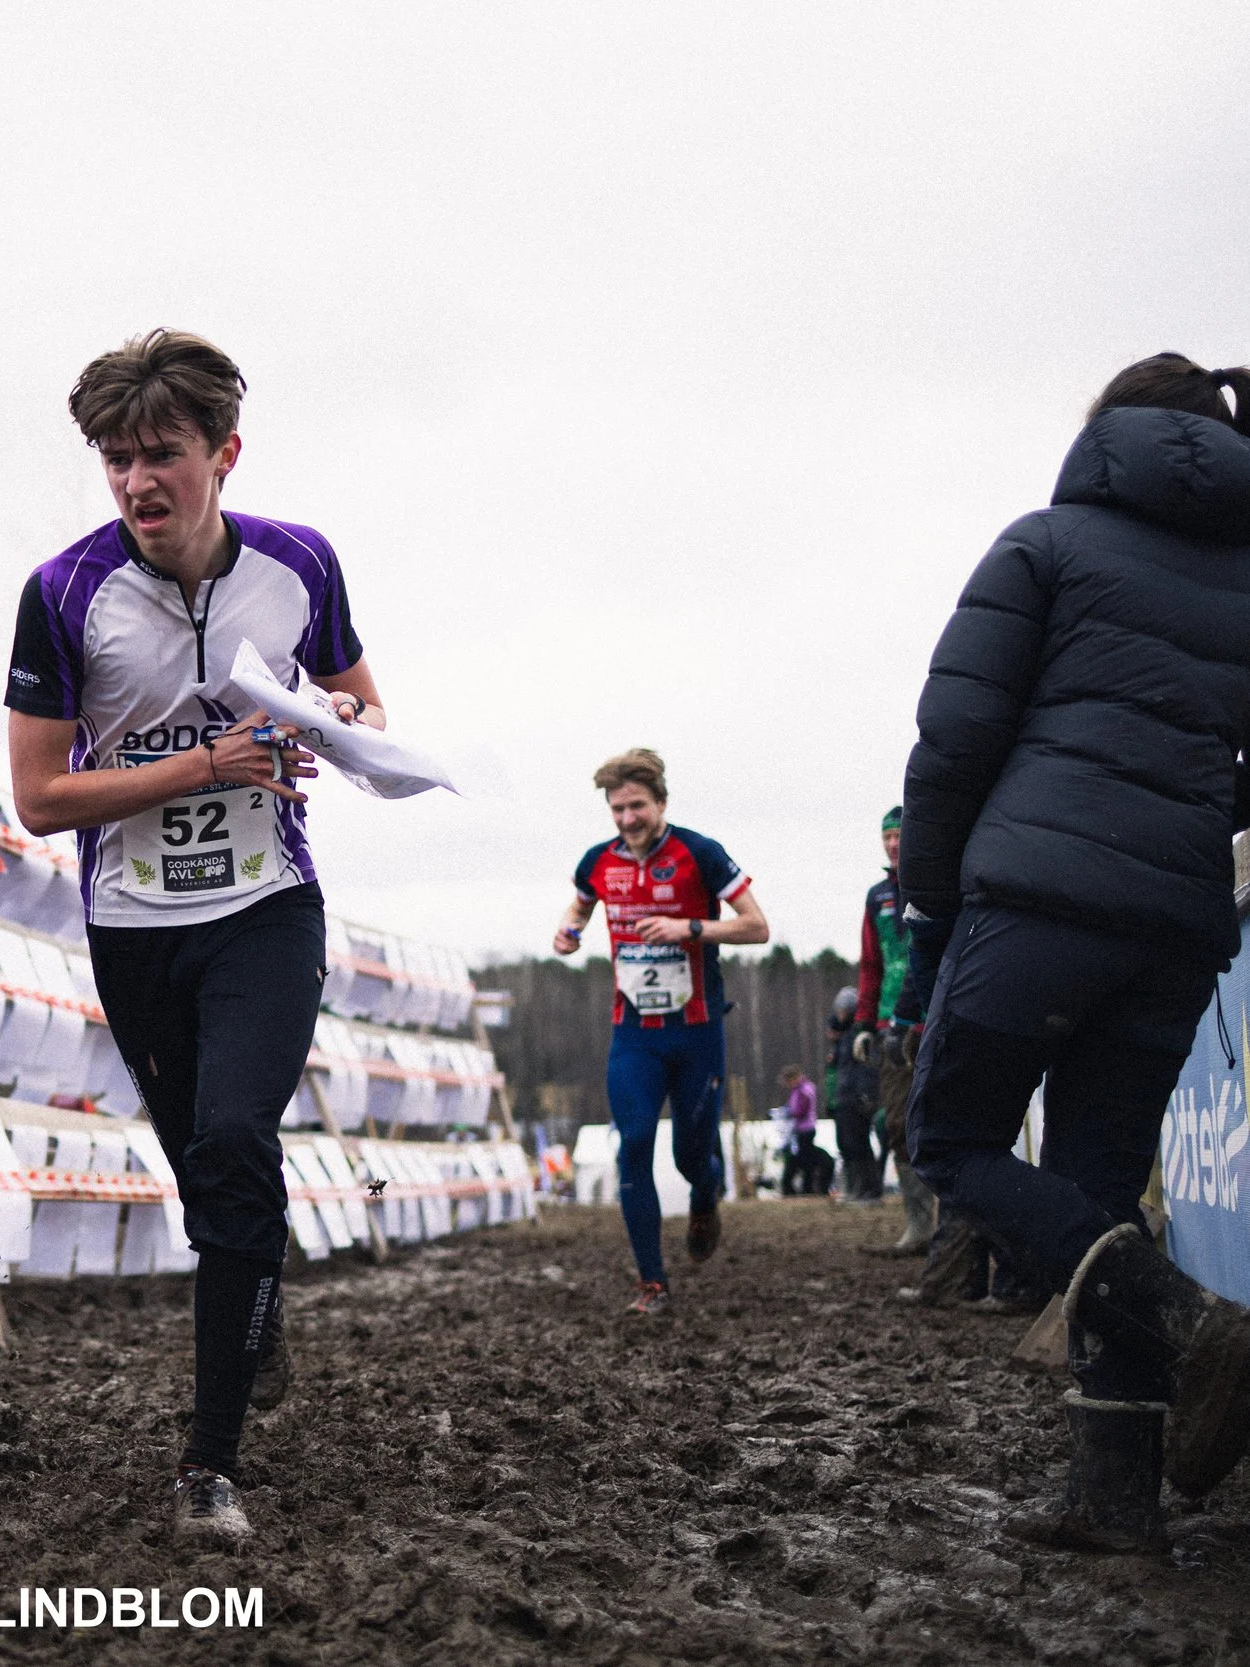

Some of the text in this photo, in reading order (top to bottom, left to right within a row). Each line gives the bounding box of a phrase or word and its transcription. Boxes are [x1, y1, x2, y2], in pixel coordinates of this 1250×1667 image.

[11, 668, 41, 684] SÖDERS
[250, 791, 264, 810] 2
[161, 801, 230, 848] 52
[167, 856, 227, 869] GODKÄNDA
[643, 968, 660, 987] 2
[244, 1277, 273, 1351] noname
